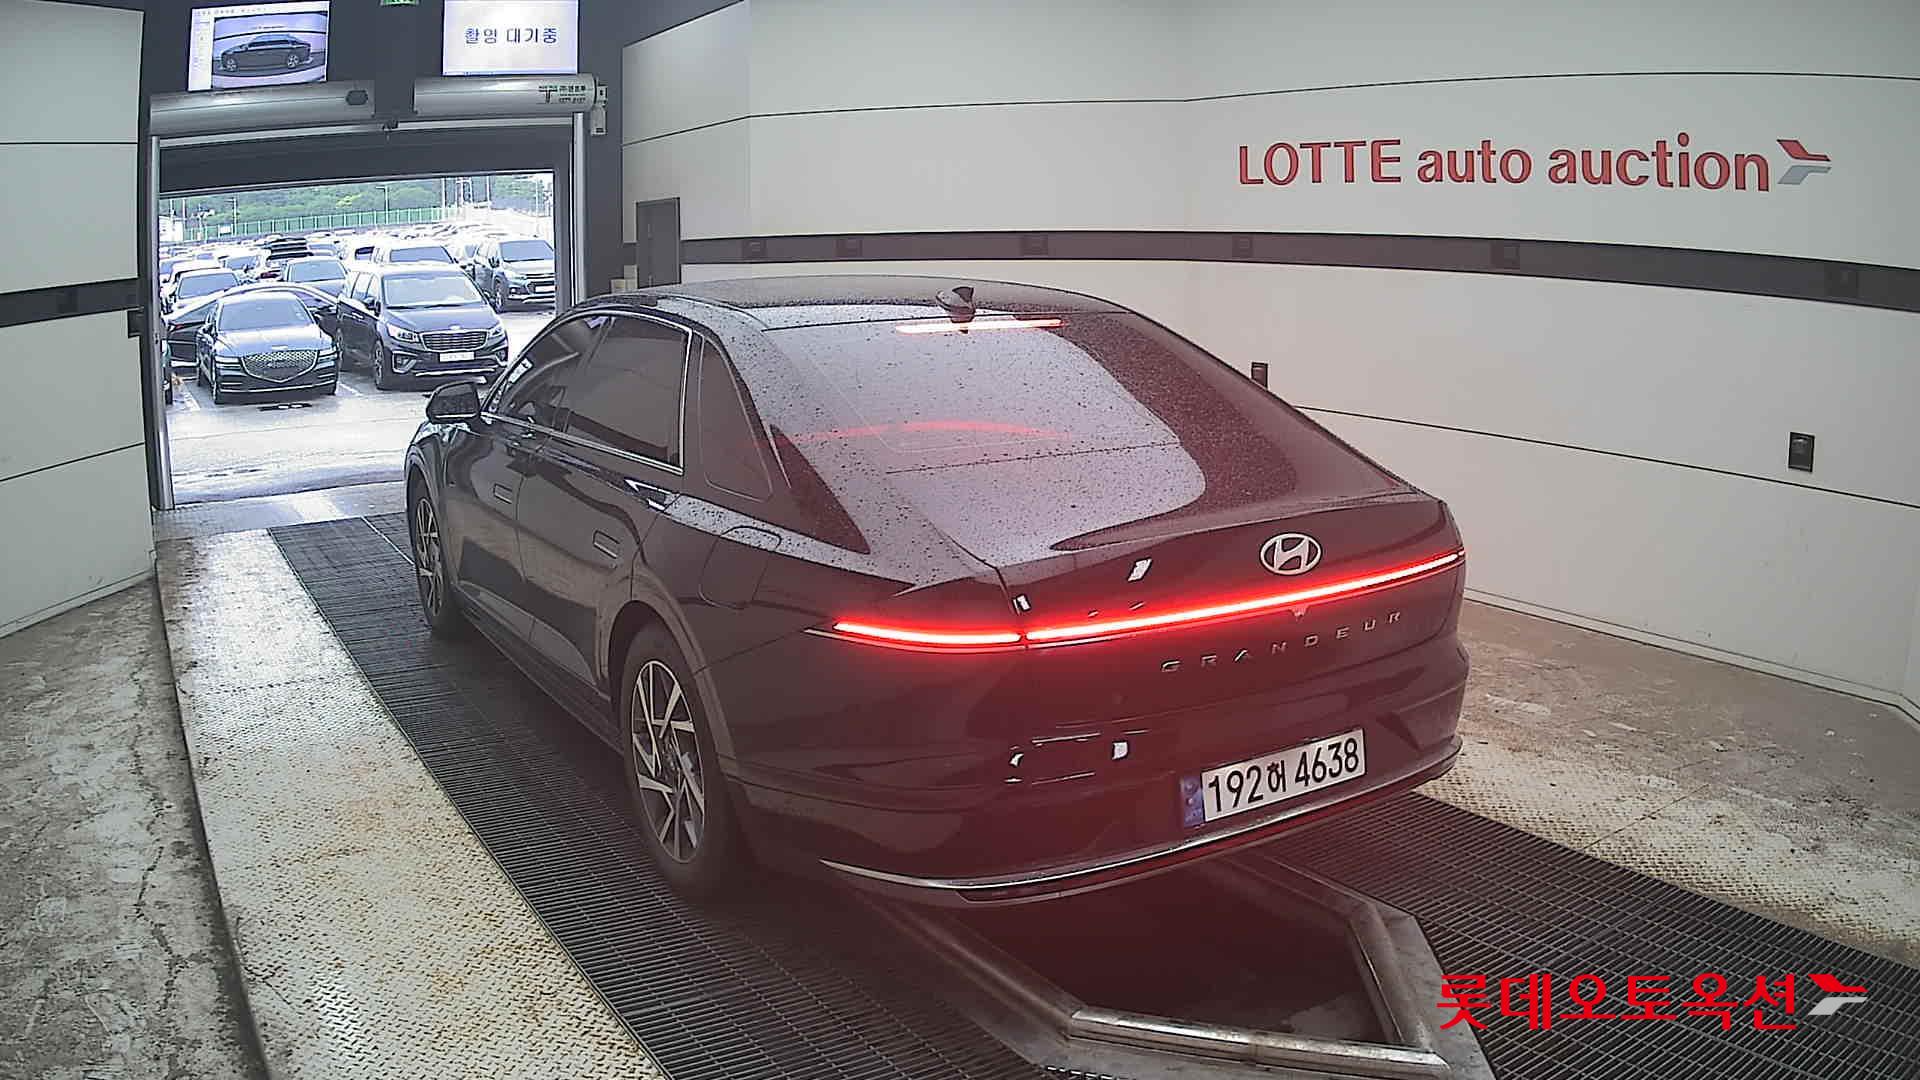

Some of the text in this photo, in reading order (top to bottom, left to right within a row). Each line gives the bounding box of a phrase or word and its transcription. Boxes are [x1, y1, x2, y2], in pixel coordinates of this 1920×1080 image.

[506, 27, 557, 44] 대기중
[1238, 132, 1770, 192] LOTTE auto auction
[1161, 611, 1401, 673] GRANDEUR
[1208, 737, 1359, 812] 192허 4638
